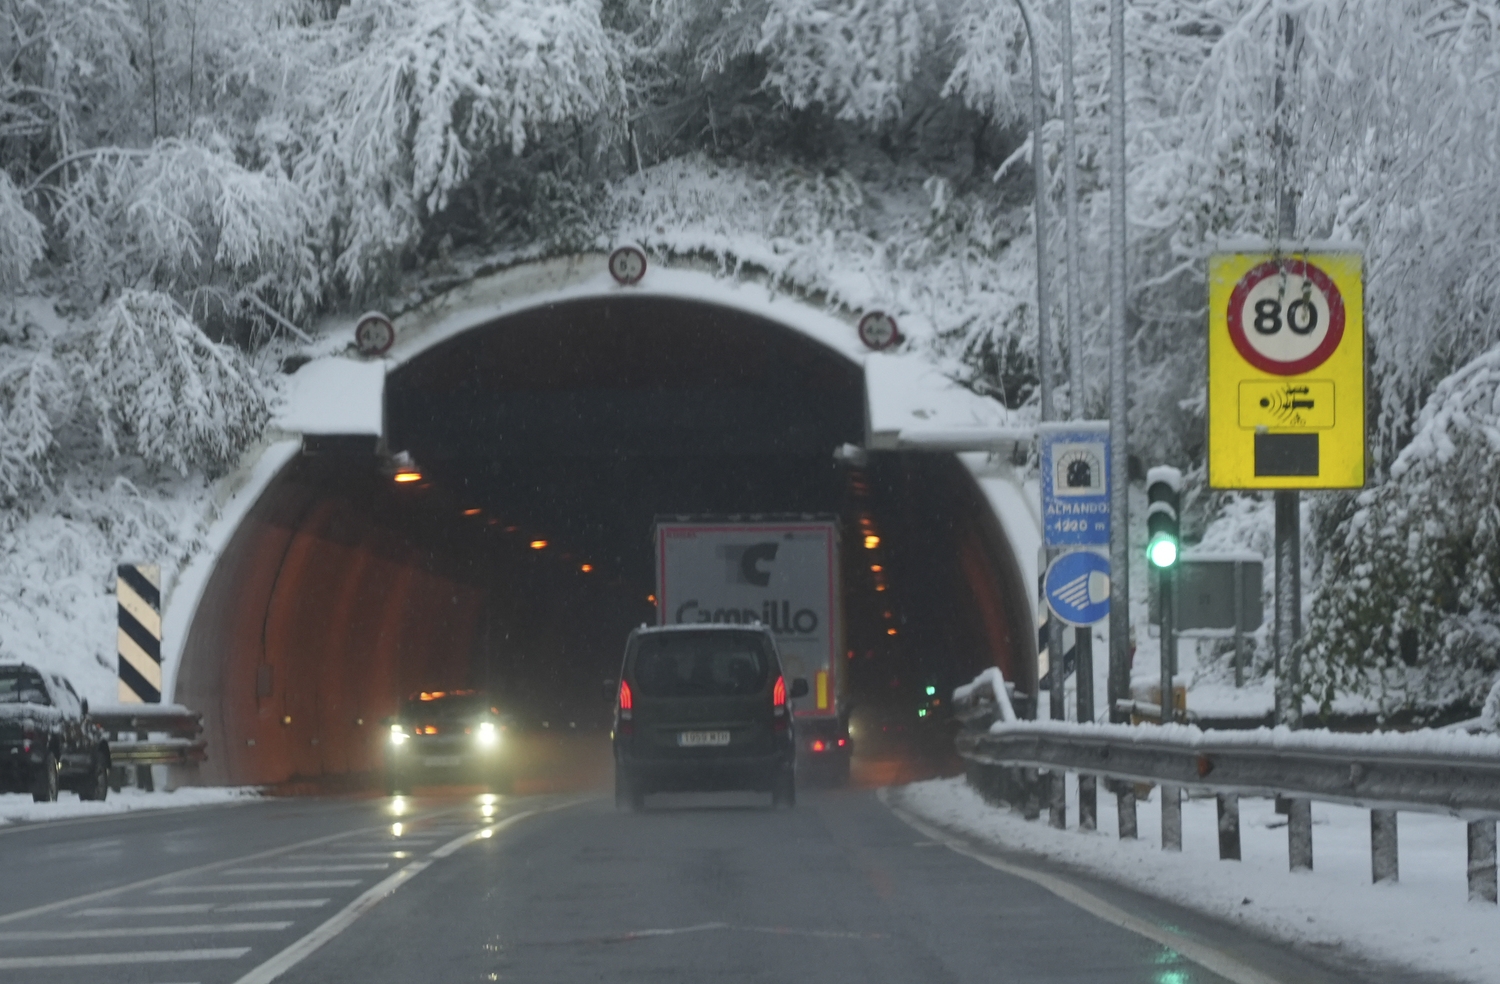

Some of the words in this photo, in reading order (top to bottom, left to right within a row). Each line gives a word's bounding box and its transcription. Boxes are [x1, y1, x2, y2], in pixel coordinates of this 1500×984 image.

[1253, 298, 1318, 335] 80
[1047, 502, 1110, 514] ALMANDO
[1094, 522, 1106, 531] m
